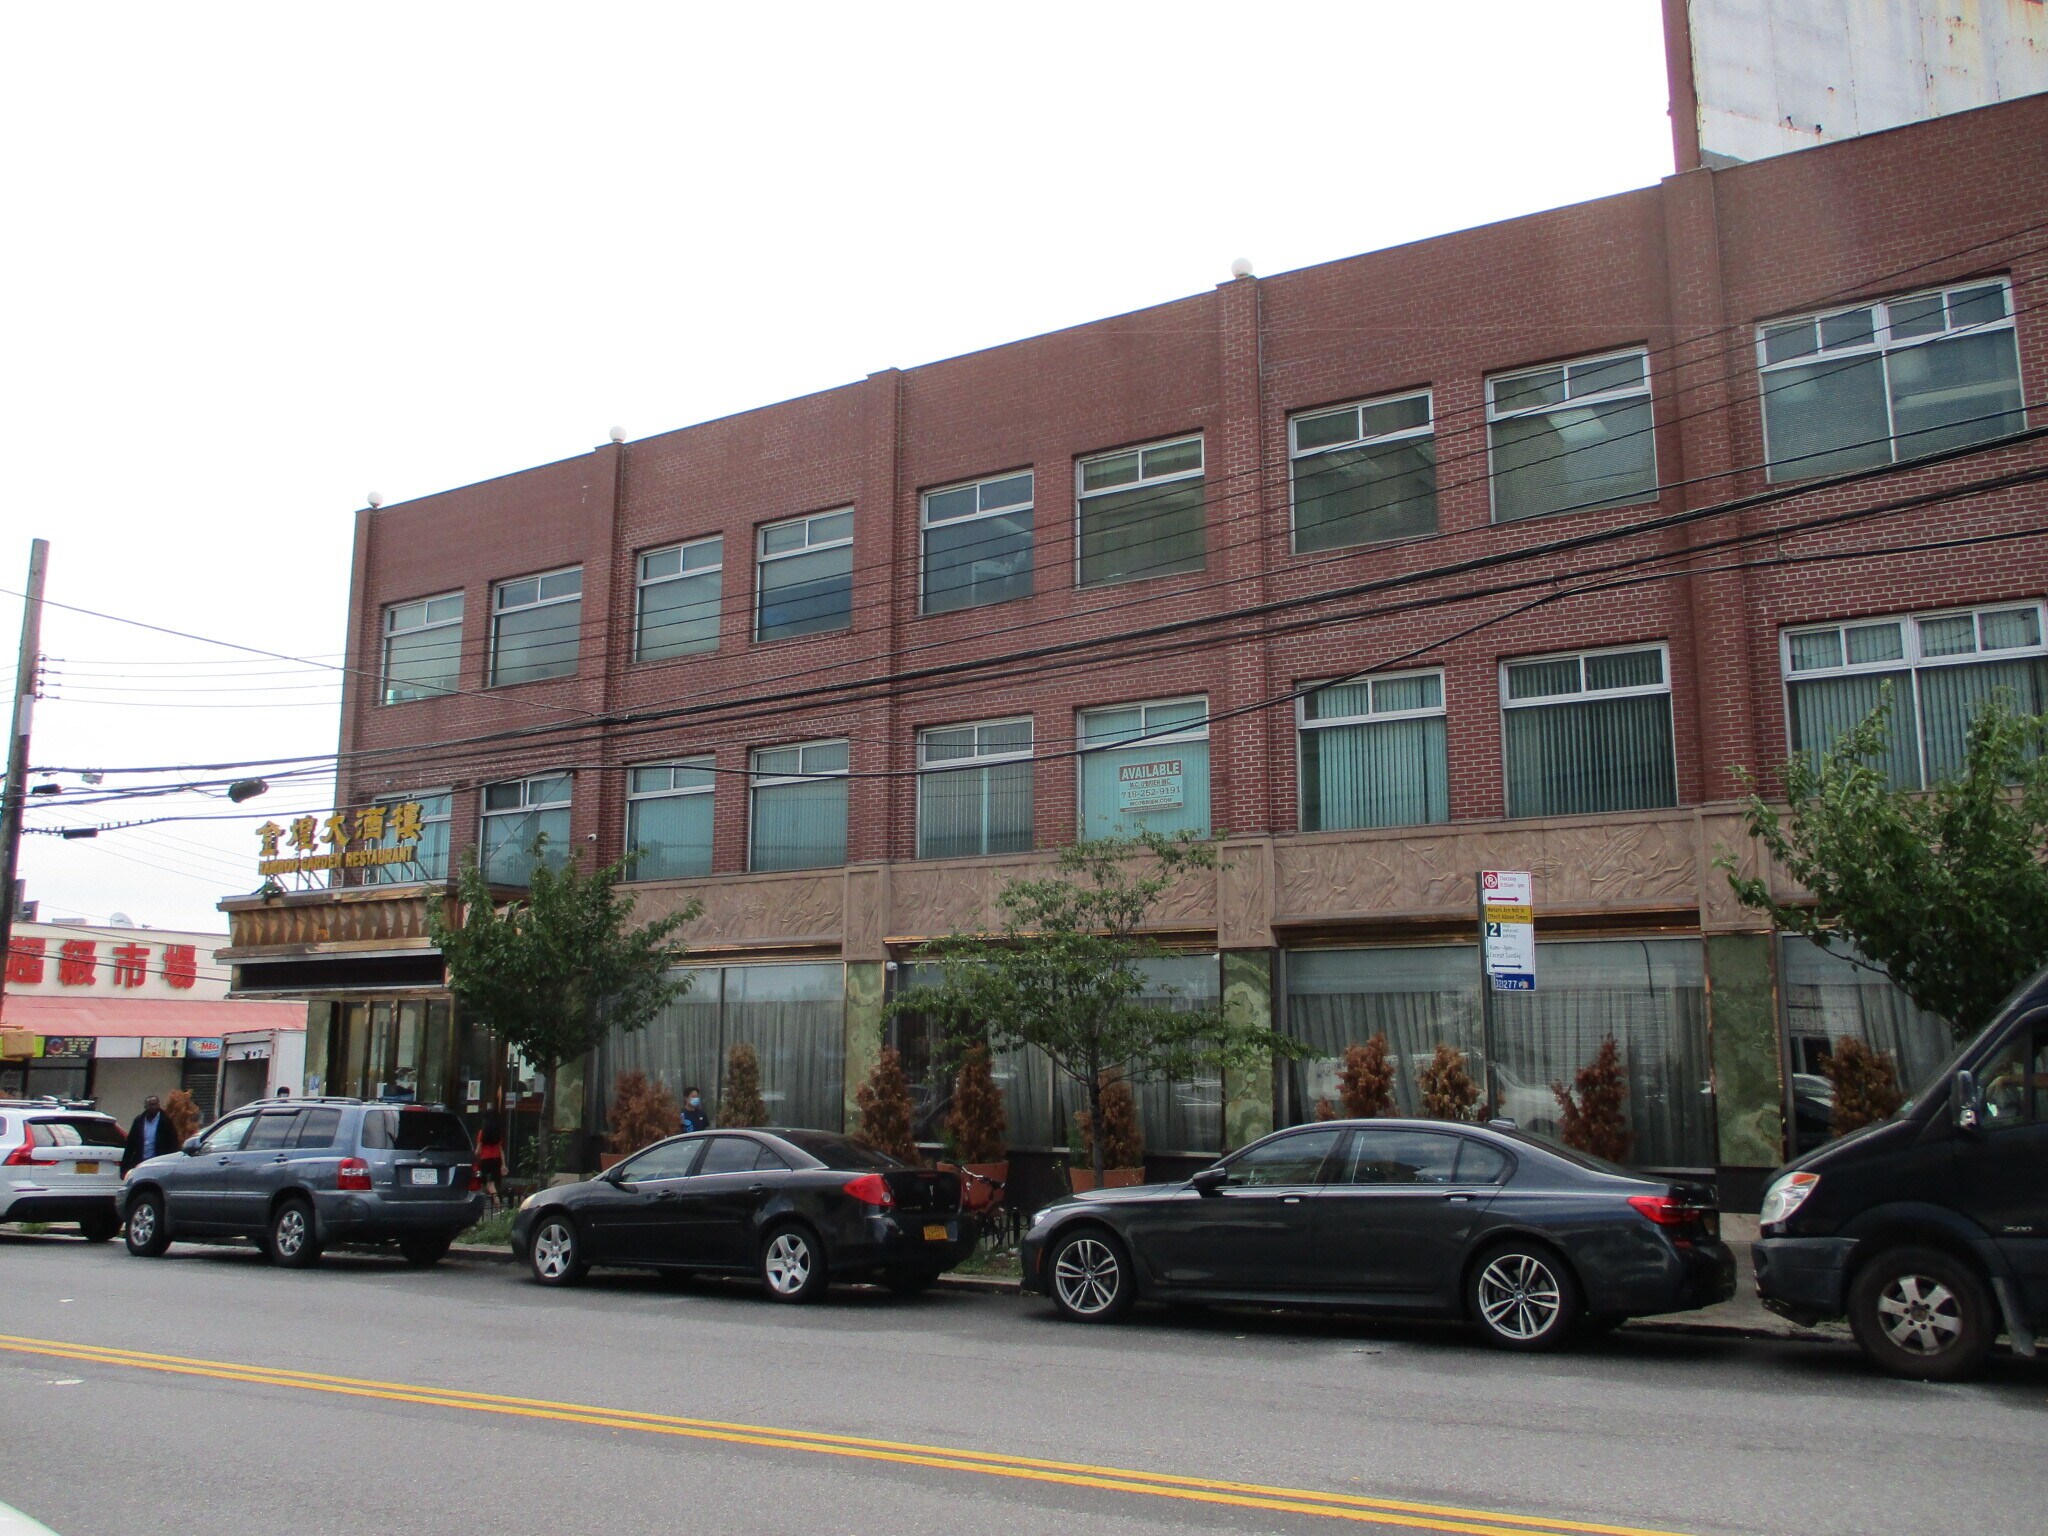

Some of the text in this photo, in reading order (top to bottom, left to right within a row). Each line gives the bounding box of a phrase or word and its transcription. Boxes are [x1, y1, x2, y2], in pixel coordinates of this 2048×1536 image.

[1121, 762, 1180, 780] AVAILABLE
[1121, 786, 1180, 799] 718-252-9191
[301, 852, 342, 871] GARDEN
[345, 845, 414, 868] RESTAURANT
[1489, 922, 1498, 936] 2
[4, 935, 197, 990] 超級市場
